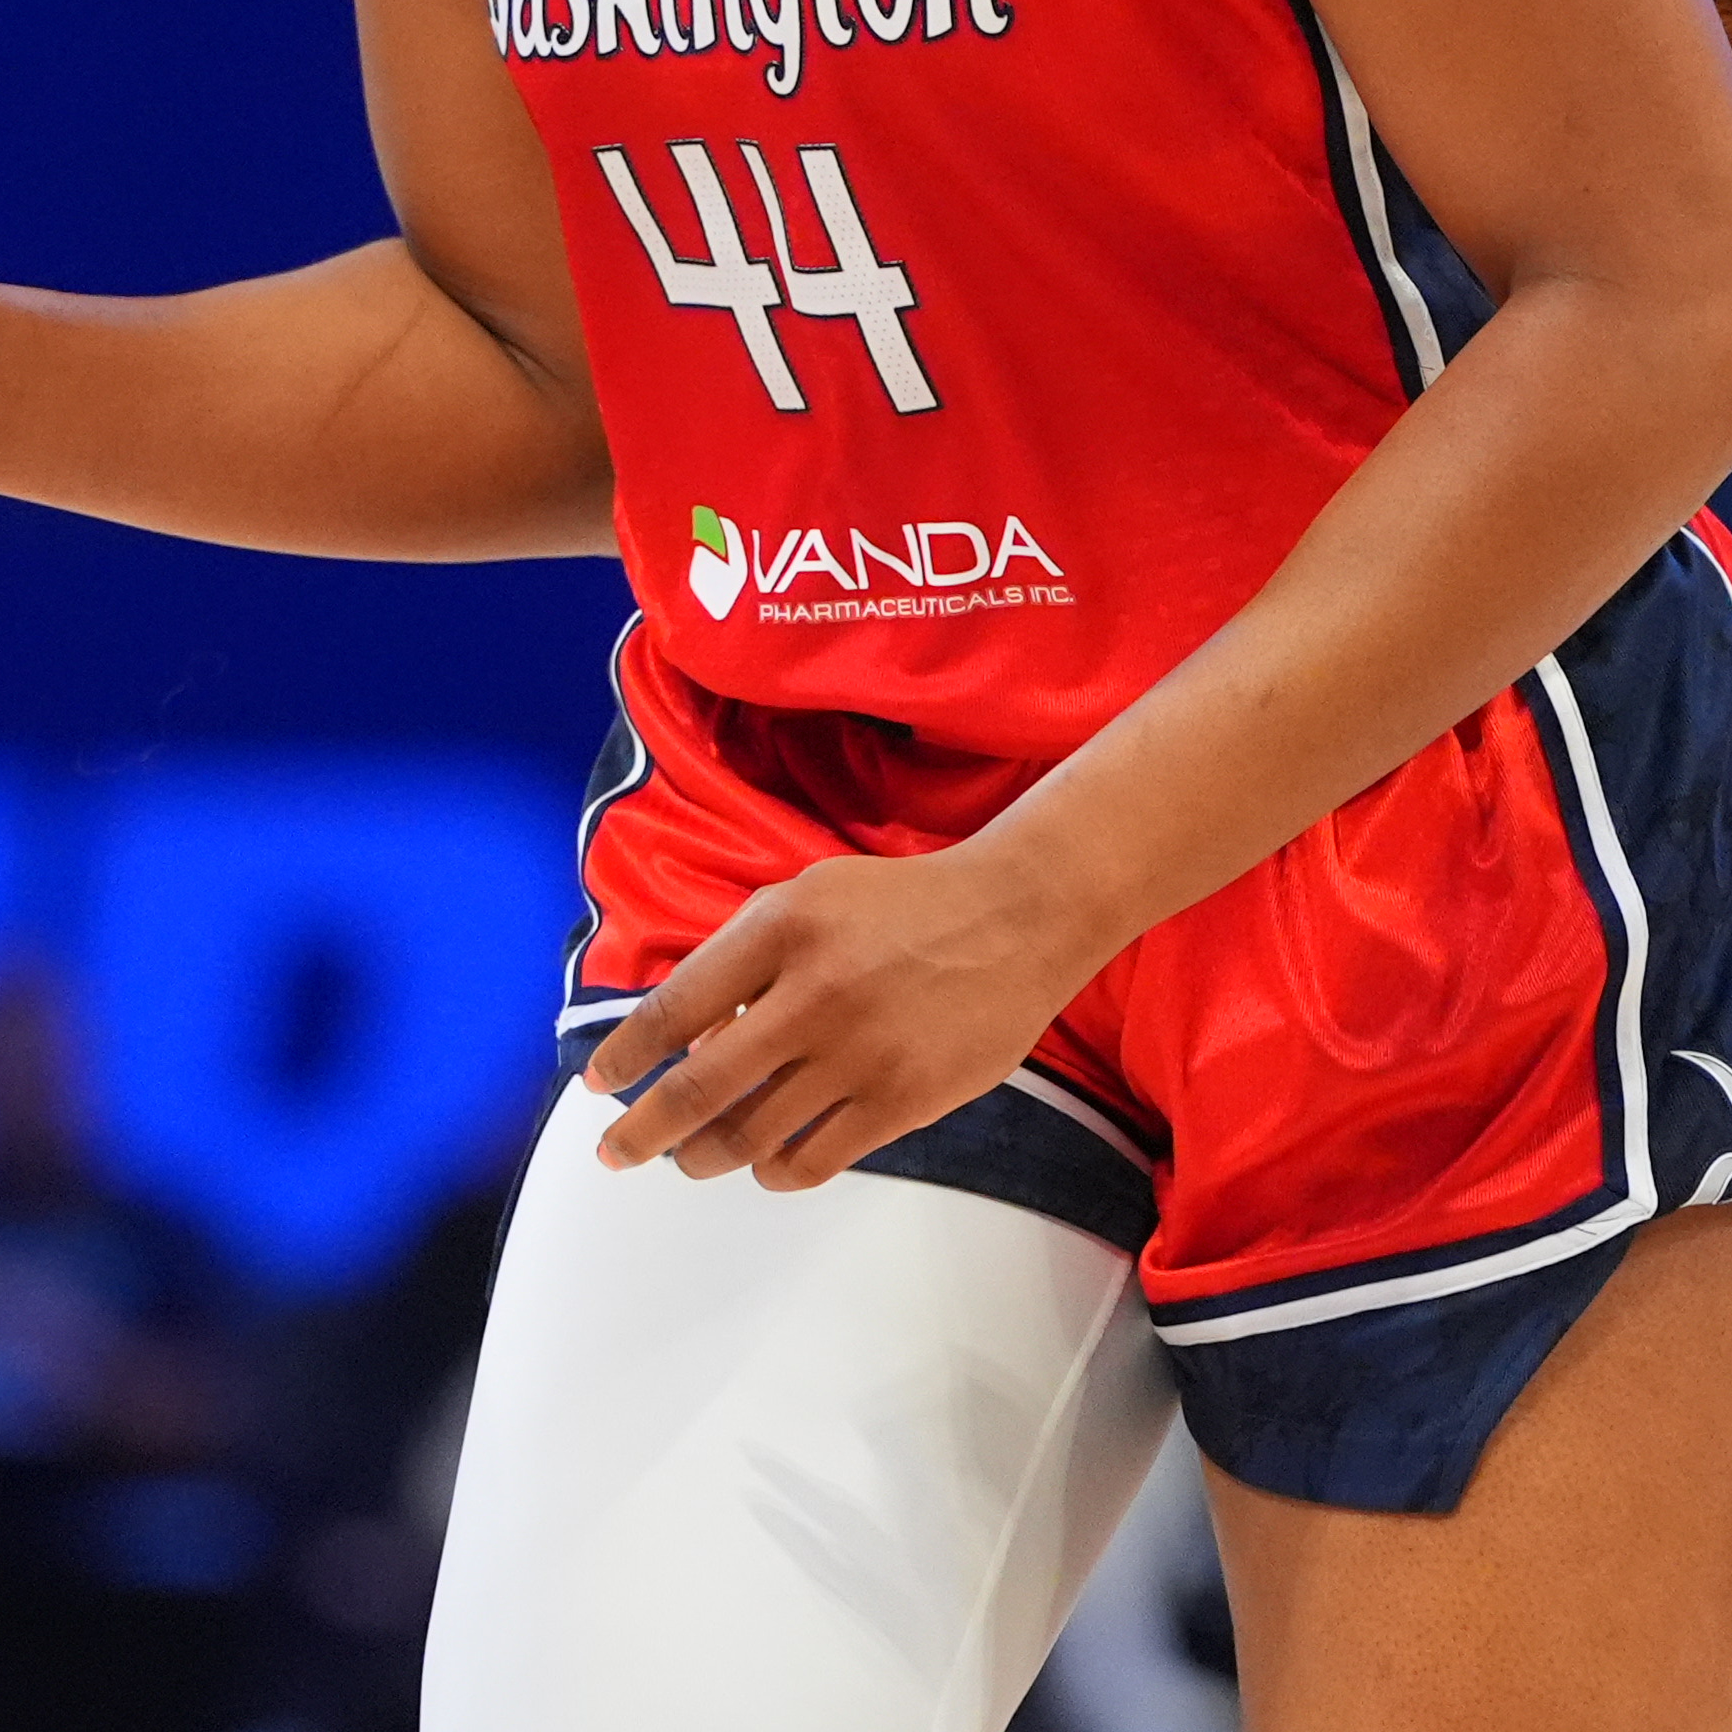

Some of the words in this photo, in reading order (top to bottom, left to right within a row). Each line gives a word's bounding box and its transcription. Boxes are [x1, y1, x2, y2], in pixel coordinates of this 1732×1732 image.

[593, 139, 944, 413] 44
[753, 515, 1064, 593] VANDA
[758, 589, 1025, 623] PHARMACEUTICALS
